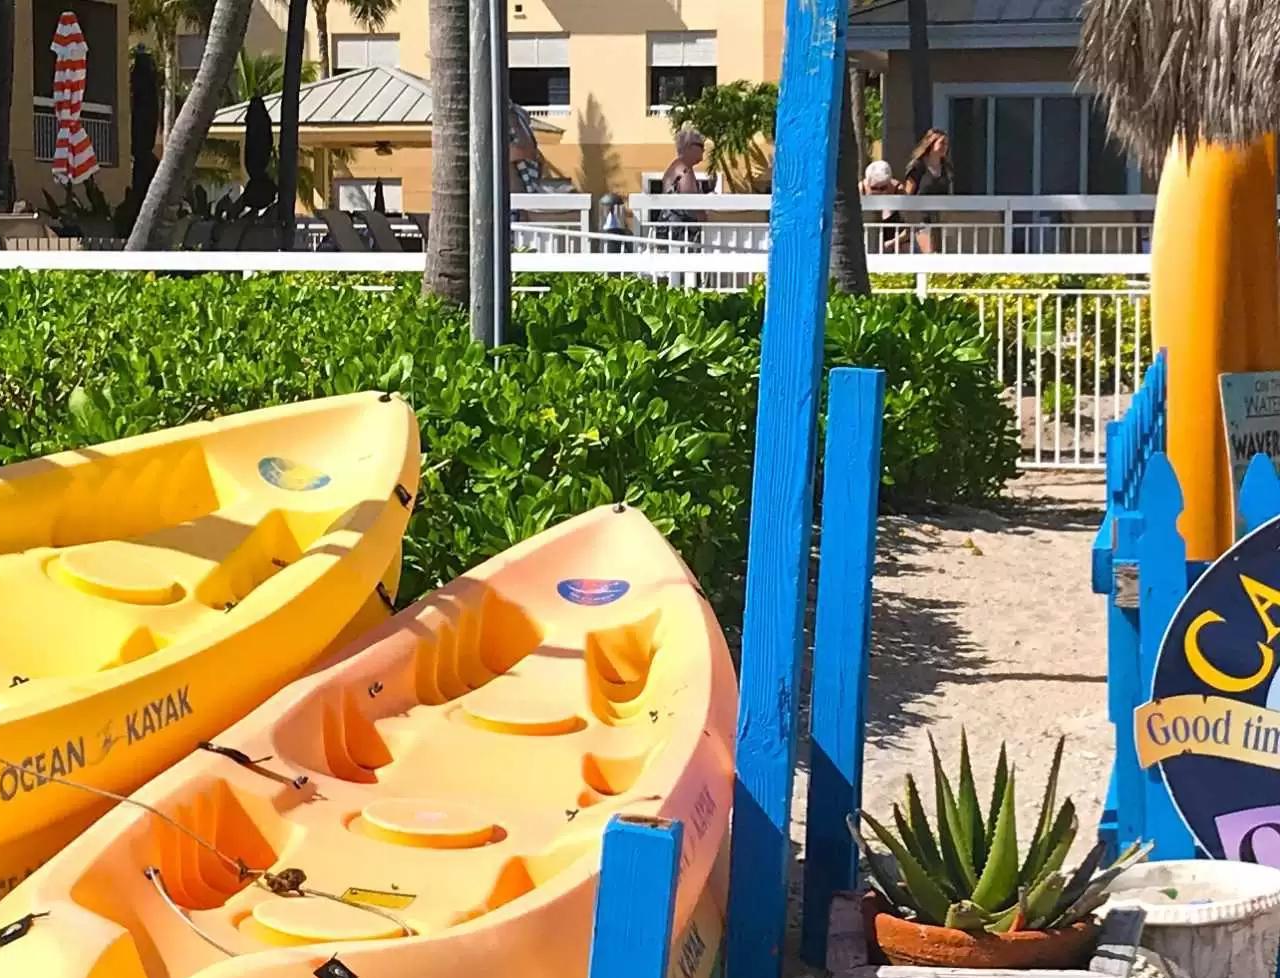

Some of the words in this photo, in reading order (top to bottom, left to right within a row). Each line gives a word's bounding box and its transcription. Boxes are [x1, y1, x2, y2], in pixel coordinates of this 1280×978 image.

[0, 736, 86, 801] OCEAN
[125, 684, 194, 746] KAYAK
[1147, 710, 1232, 746] Good
